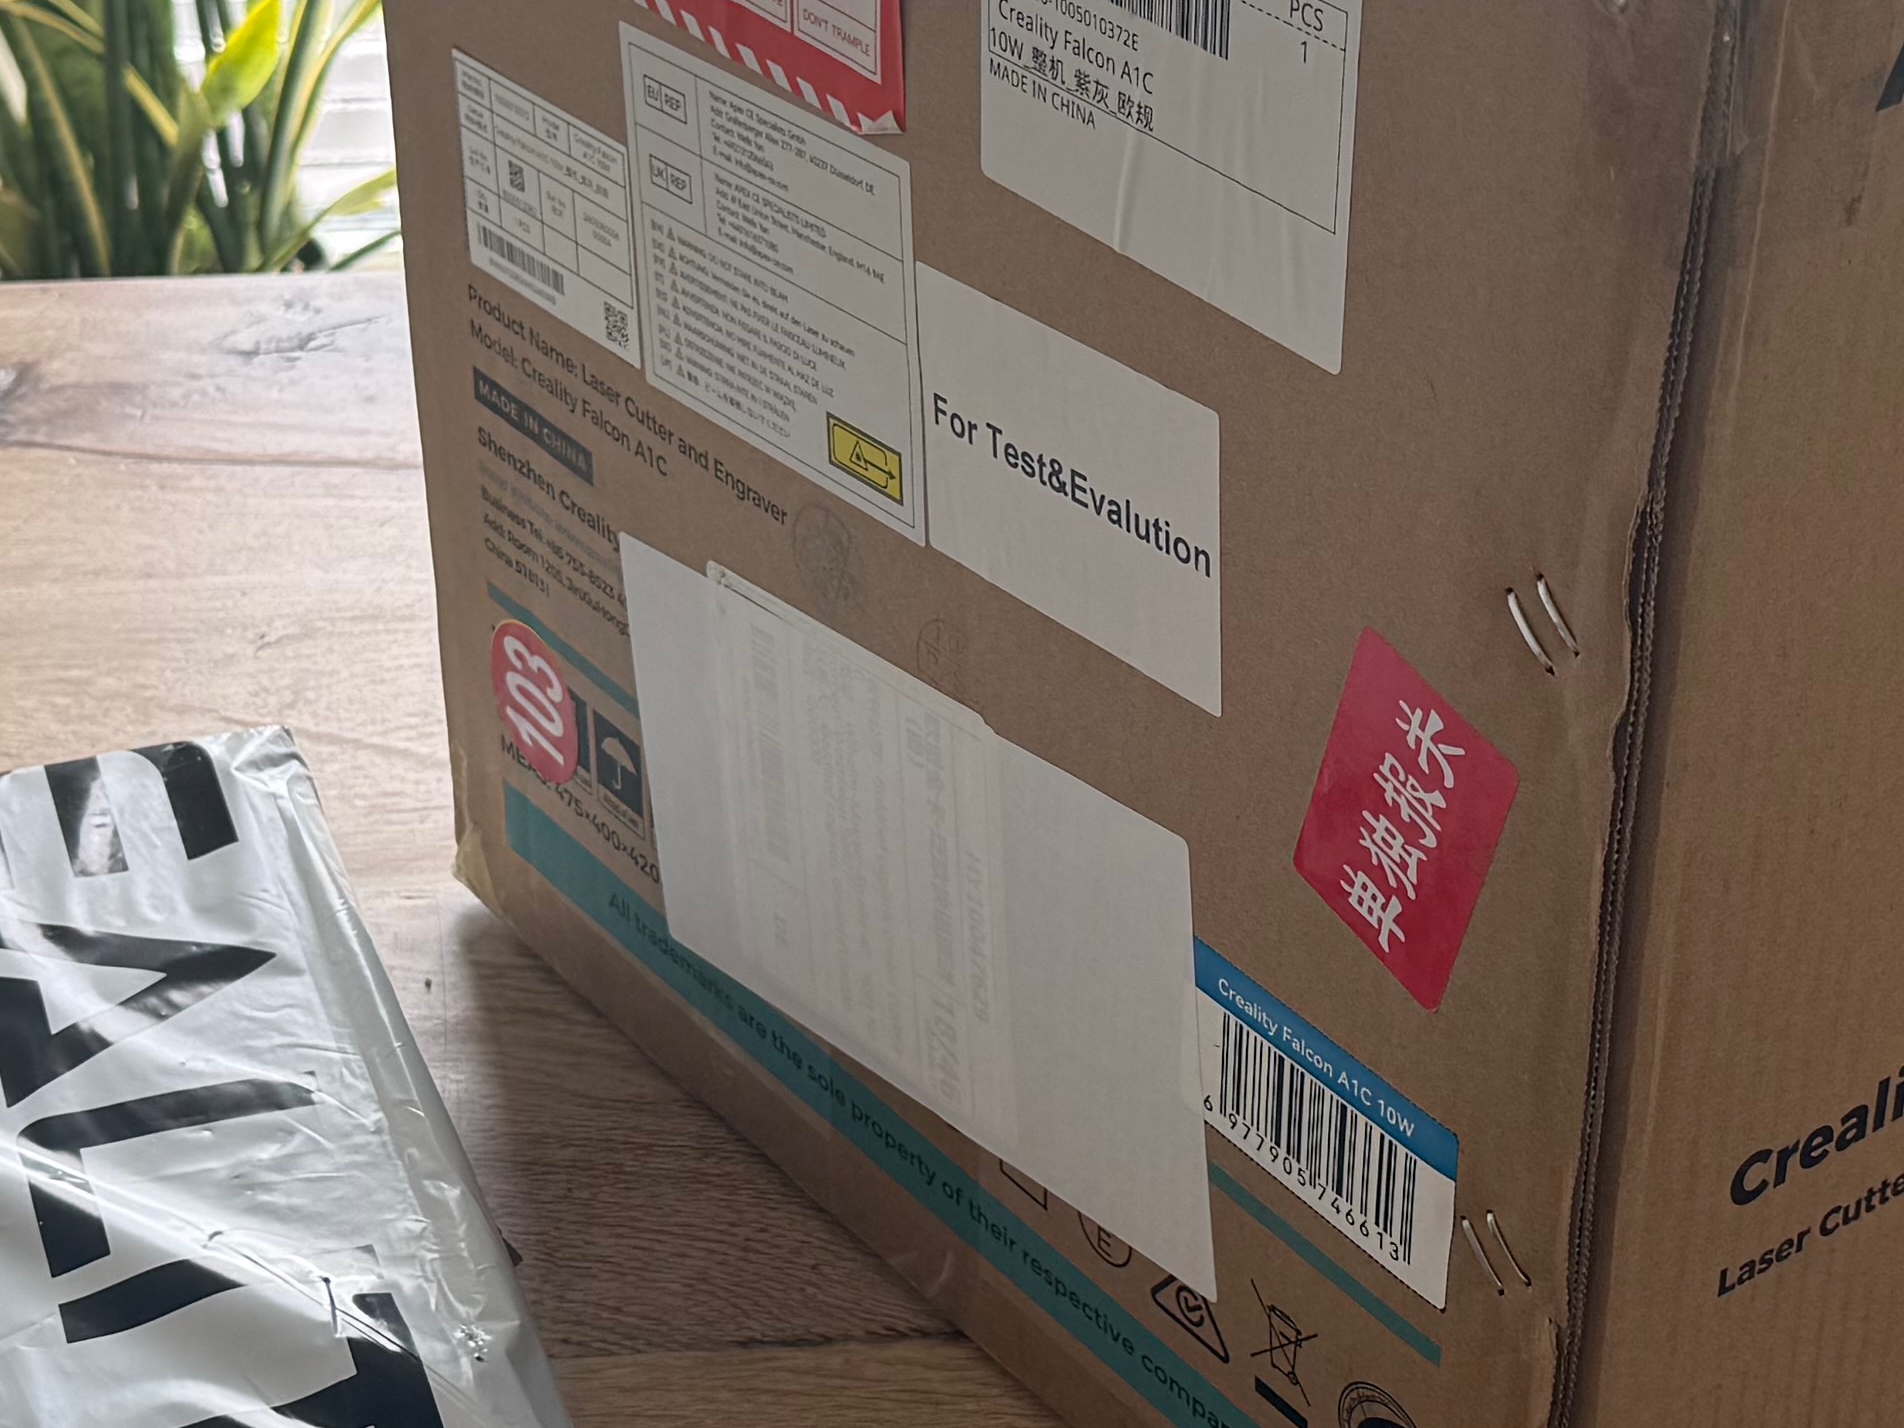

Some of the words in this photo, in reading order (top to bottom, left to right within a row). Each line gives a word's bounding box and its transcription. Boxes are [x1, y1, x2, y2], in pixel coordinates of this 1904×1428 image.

[989, 57, 1028, 94] MADE
[1032, 79, 1047, 103] IN
[1051, 88, 1097, 131] CHINA
[1064, 31, 1116, 73] Falcon
[1120, 60, 1153, 96] A1C
[1299, 40, 1309, 64] 1
[468, 282, 526, 341] Product
[529, 330, 578, 376] Name:
[581, 362, 622, 406] Laser
[624, 396, 675, 446] Cutter
[677, 434, 710, 472] and
[714, 457, 789, 526] Engraver
[469, 319, 519, 369] Model:
[521, 356, 578, 414] Creality
[581, 397, 632, 452] Falcon
[634, 438, 669, 478] A1C
[478, 378, 520, 421] MADE
[524, 408, 540, 437] IN
[543, 425, 590, 473] CHINA
[477, 425, 556, 501] Shenzhen
[558, 488, 621, 555] Creality
[932, 391, 979, 446] For
[985, 421, 1211, 578] Test&Evalution
[503, 635, 564, 765] 103
[1218, 978, 1279, 1037] Creality
[1282, 1026, 1334, 1078] Falcon
[1337, 1070, 1372, 1107] A1C
[1377, 1098, 1415, 1138] 10W
[609, 892, 631, 923] All
[634, 911, 734, 1010] trademarks
[738, 1005, 767, 1039] are
[771, 1030, 802, 1069] the
[807, 1064, 846, 1105] sole
[850, 1099, 937, 1187] property
[941, 1179, 965, 1207] of
[969, 1200, 1017, 1252] their
[1022, 1249, 1136, 1357] respective
[1717, 1229, 1809, 1297] Laser
